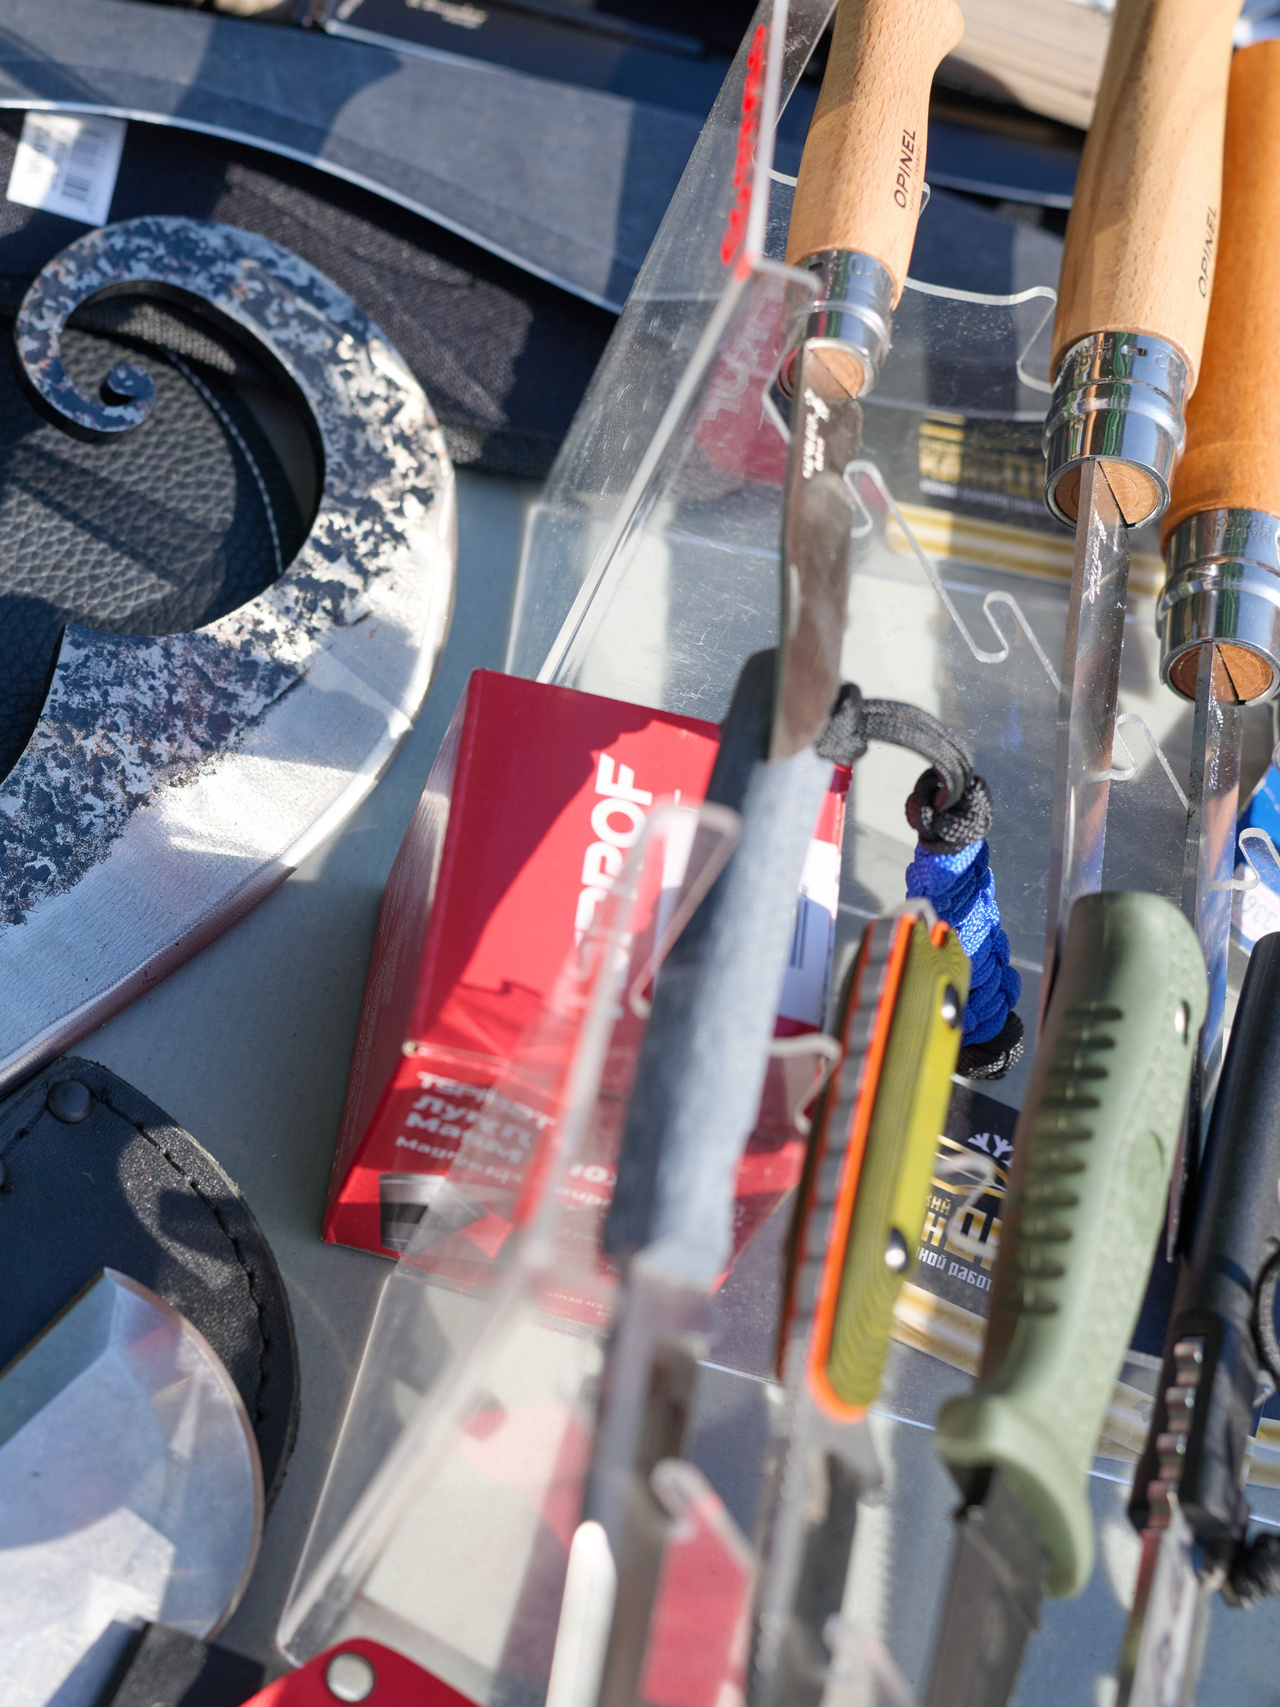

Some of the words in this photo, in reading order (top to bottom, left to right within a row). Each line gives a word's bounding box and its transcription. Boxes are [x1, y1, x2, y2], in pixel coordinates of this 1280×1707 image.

[893, 128, 916, 209] OPINEL
[1198, 205, 1217, 298] OPINEL
[916, 1245, 946, 1271] ной
